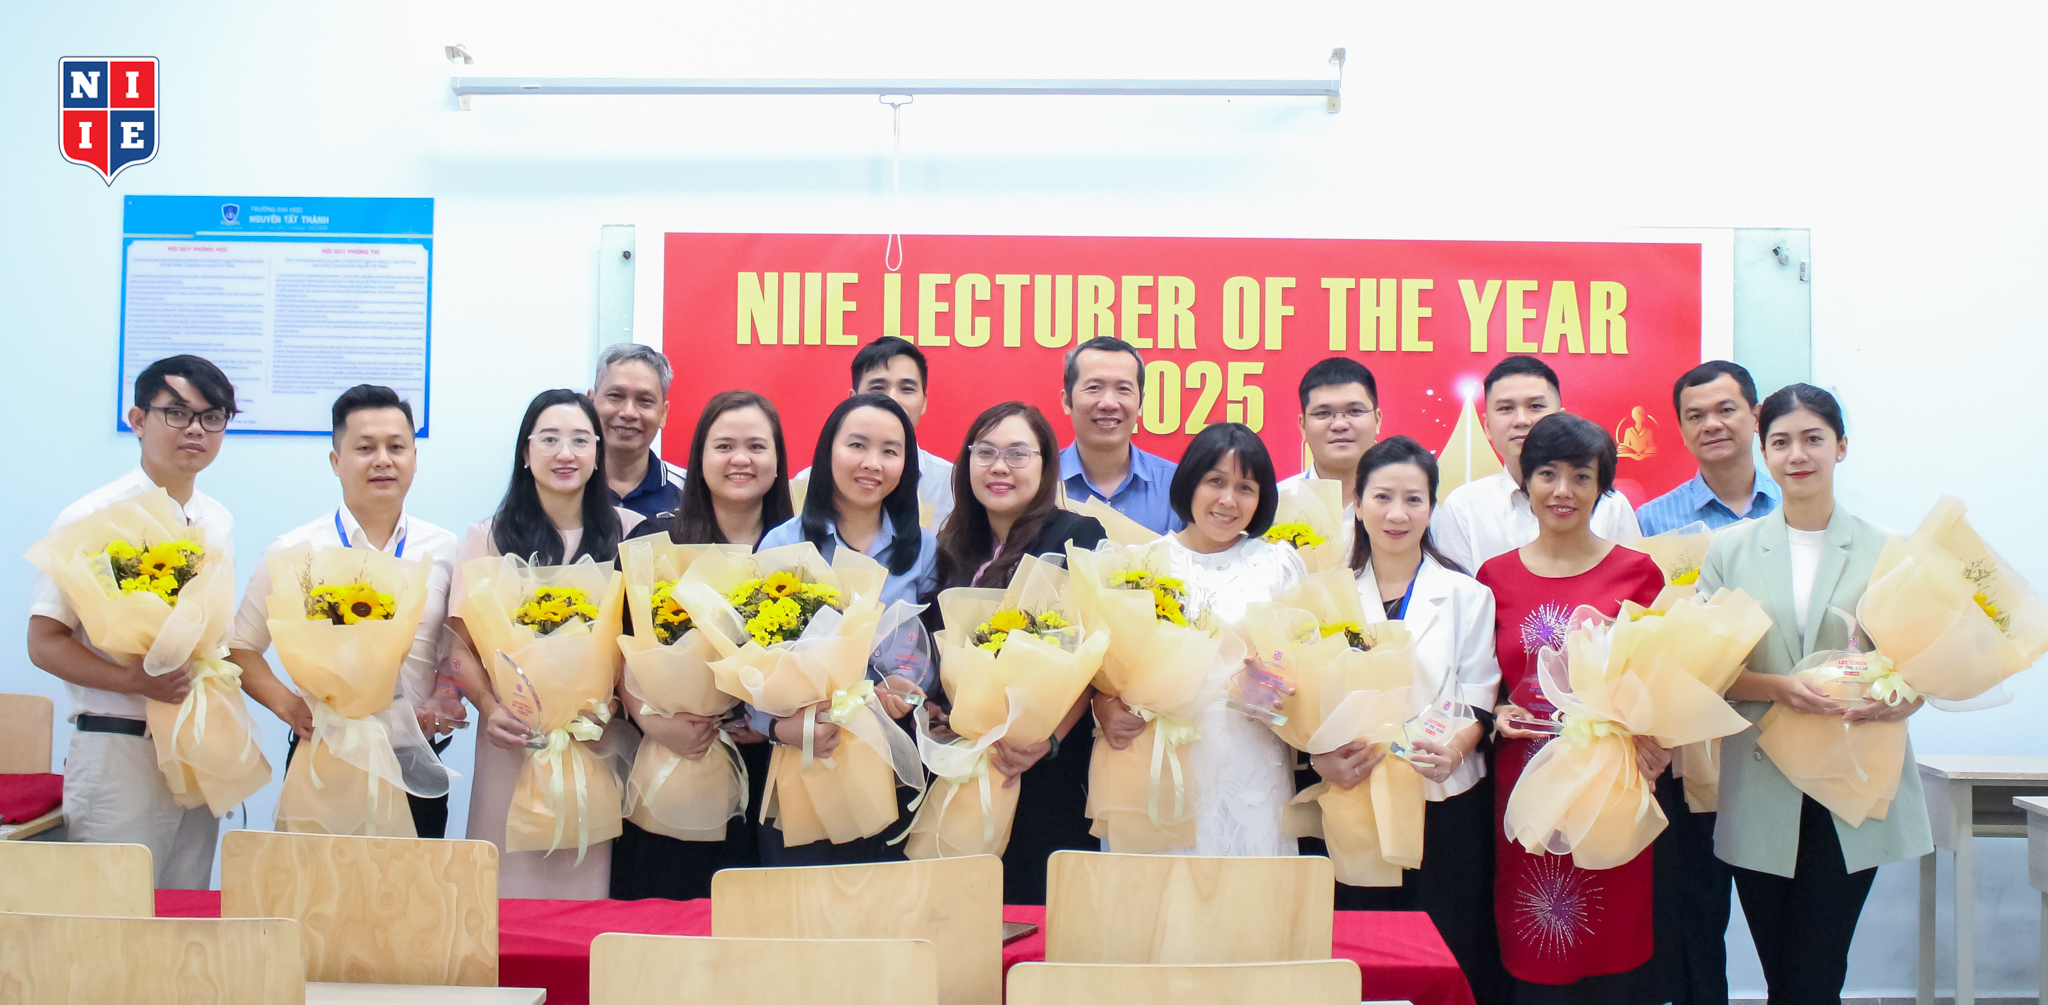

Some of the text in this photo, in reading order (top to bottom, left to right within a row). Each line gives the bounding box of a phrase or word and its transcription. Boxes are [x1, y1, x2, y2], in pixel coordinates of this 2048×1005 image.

[736, 271, 1629, 355] NIIE LECTURER OF THE YEAR
[1132, 360, 1265, 435] 025
